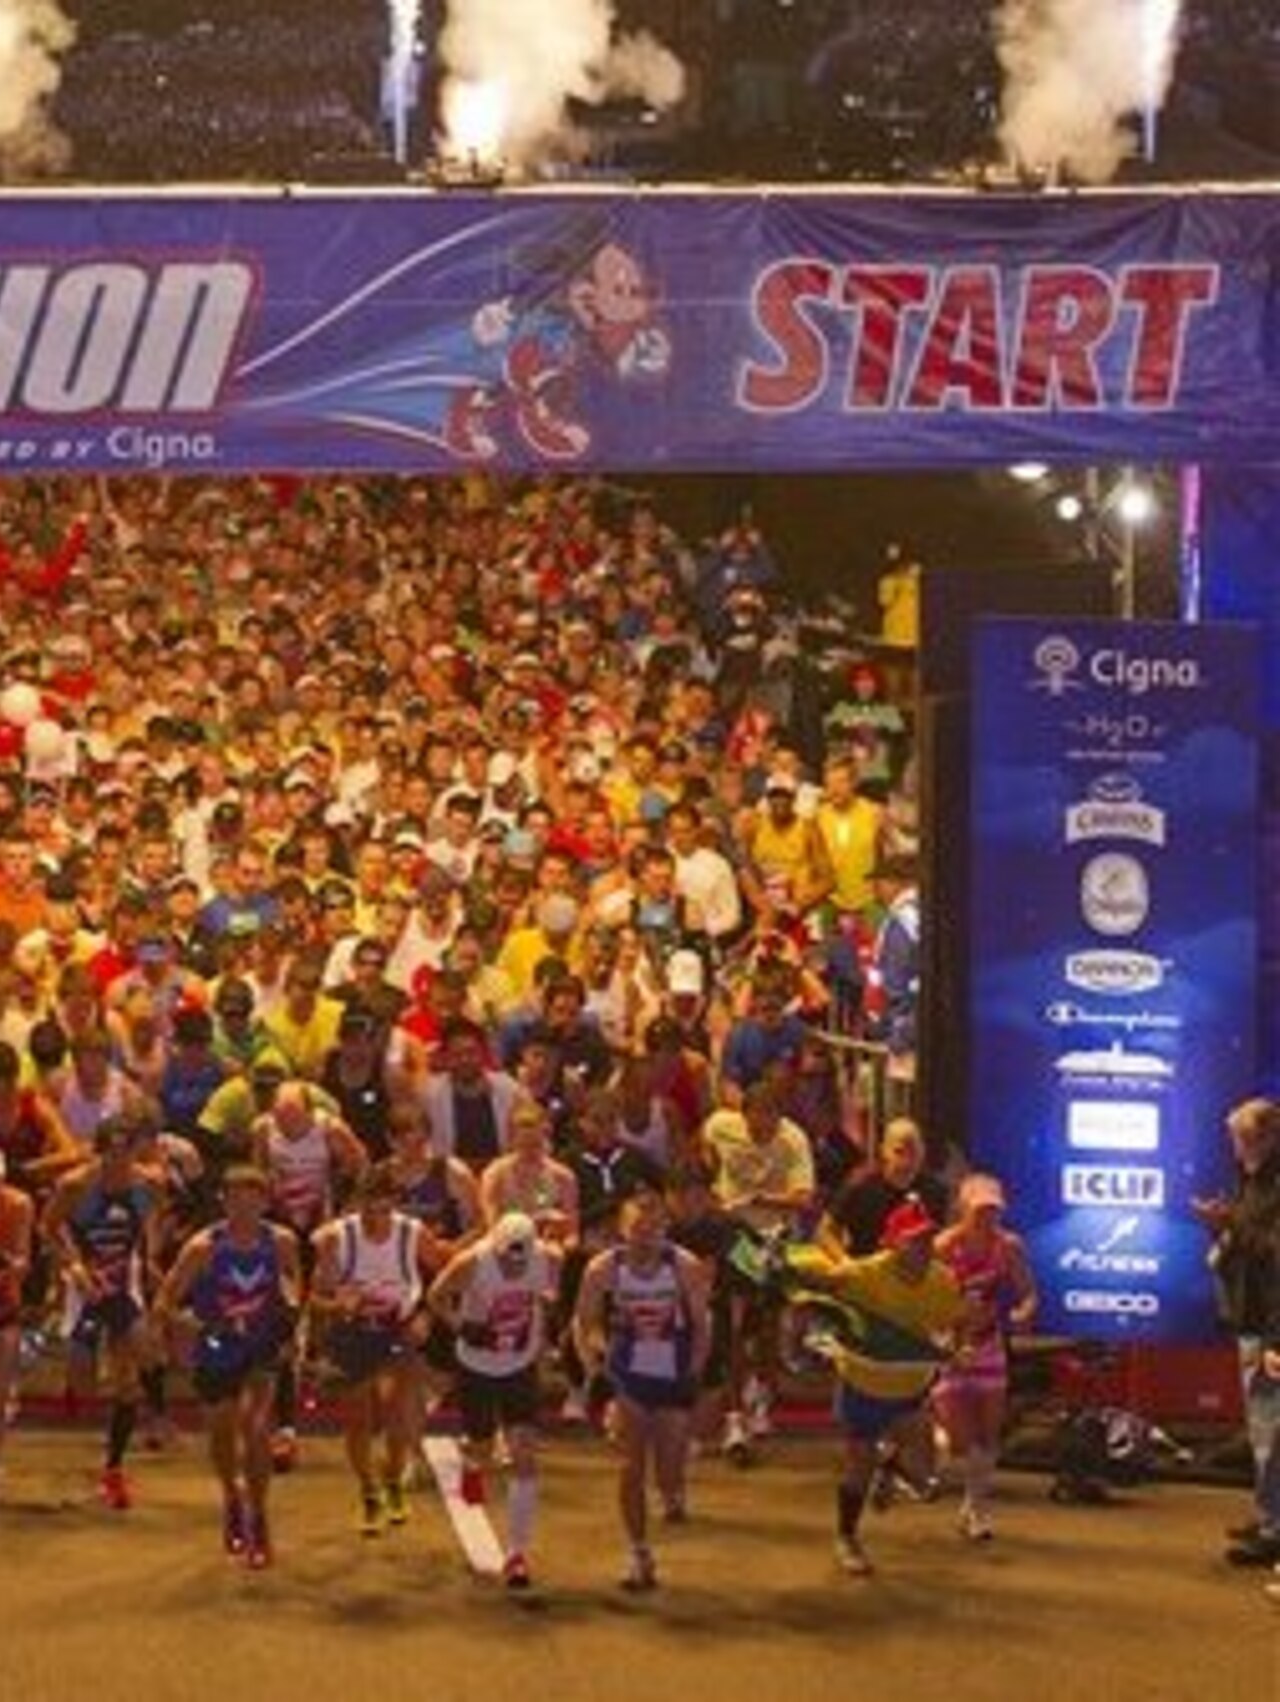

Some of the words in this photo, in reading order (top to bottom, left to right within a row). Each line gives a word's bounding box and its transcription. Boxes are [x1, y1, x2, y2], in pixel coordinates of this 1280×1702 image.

[736, 255, 1220, 412] START
[50, 440, 96, 460] BY
[106, 425, 215, 468] Cigna
[1091, 649, 1199, 693] Cigna
